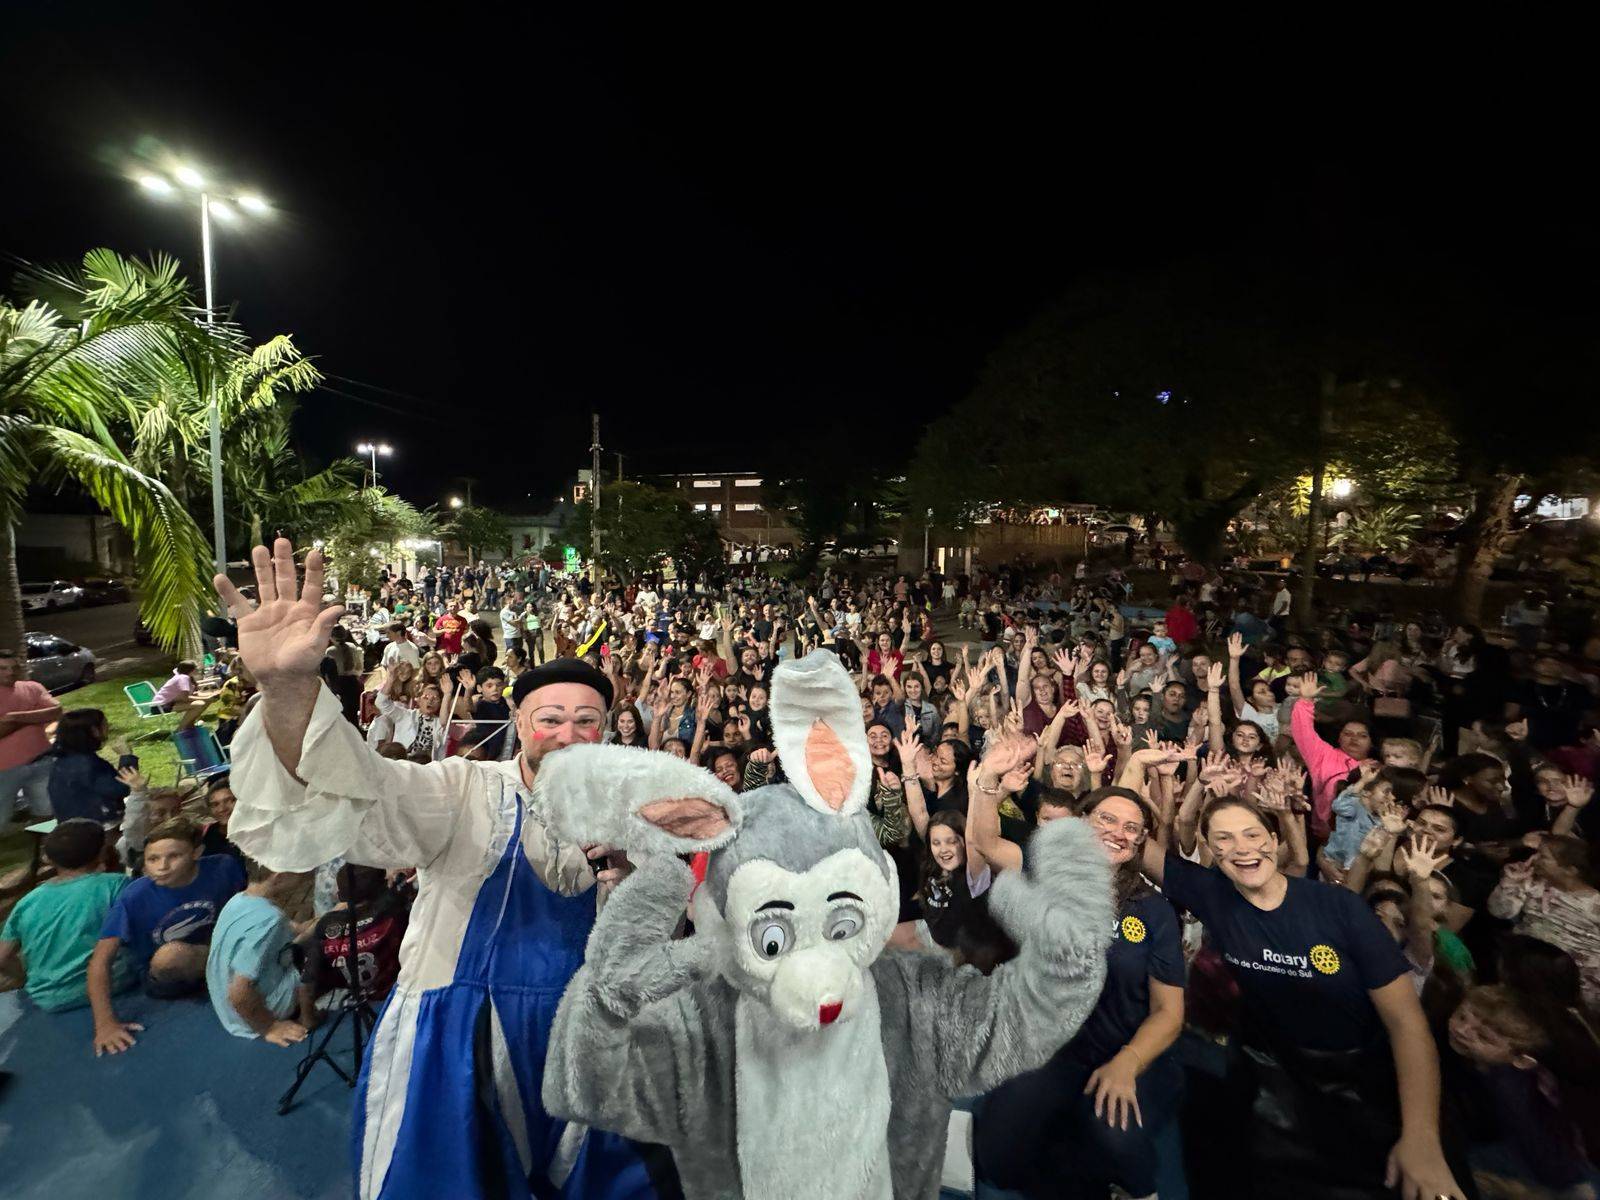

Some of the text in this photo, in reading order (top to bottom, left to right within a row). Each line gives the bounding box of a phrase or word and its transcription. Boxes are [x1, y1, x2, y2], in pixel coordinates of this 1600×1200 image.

[1263, 948, 1308, 969] Rotary
[1240, 960, 1251, 969] de
[1252, 961, 1287, 975] Cruzeiro
[1287, 968, 1298, 977] do
[1298, 969, 1313, 978] Sul
